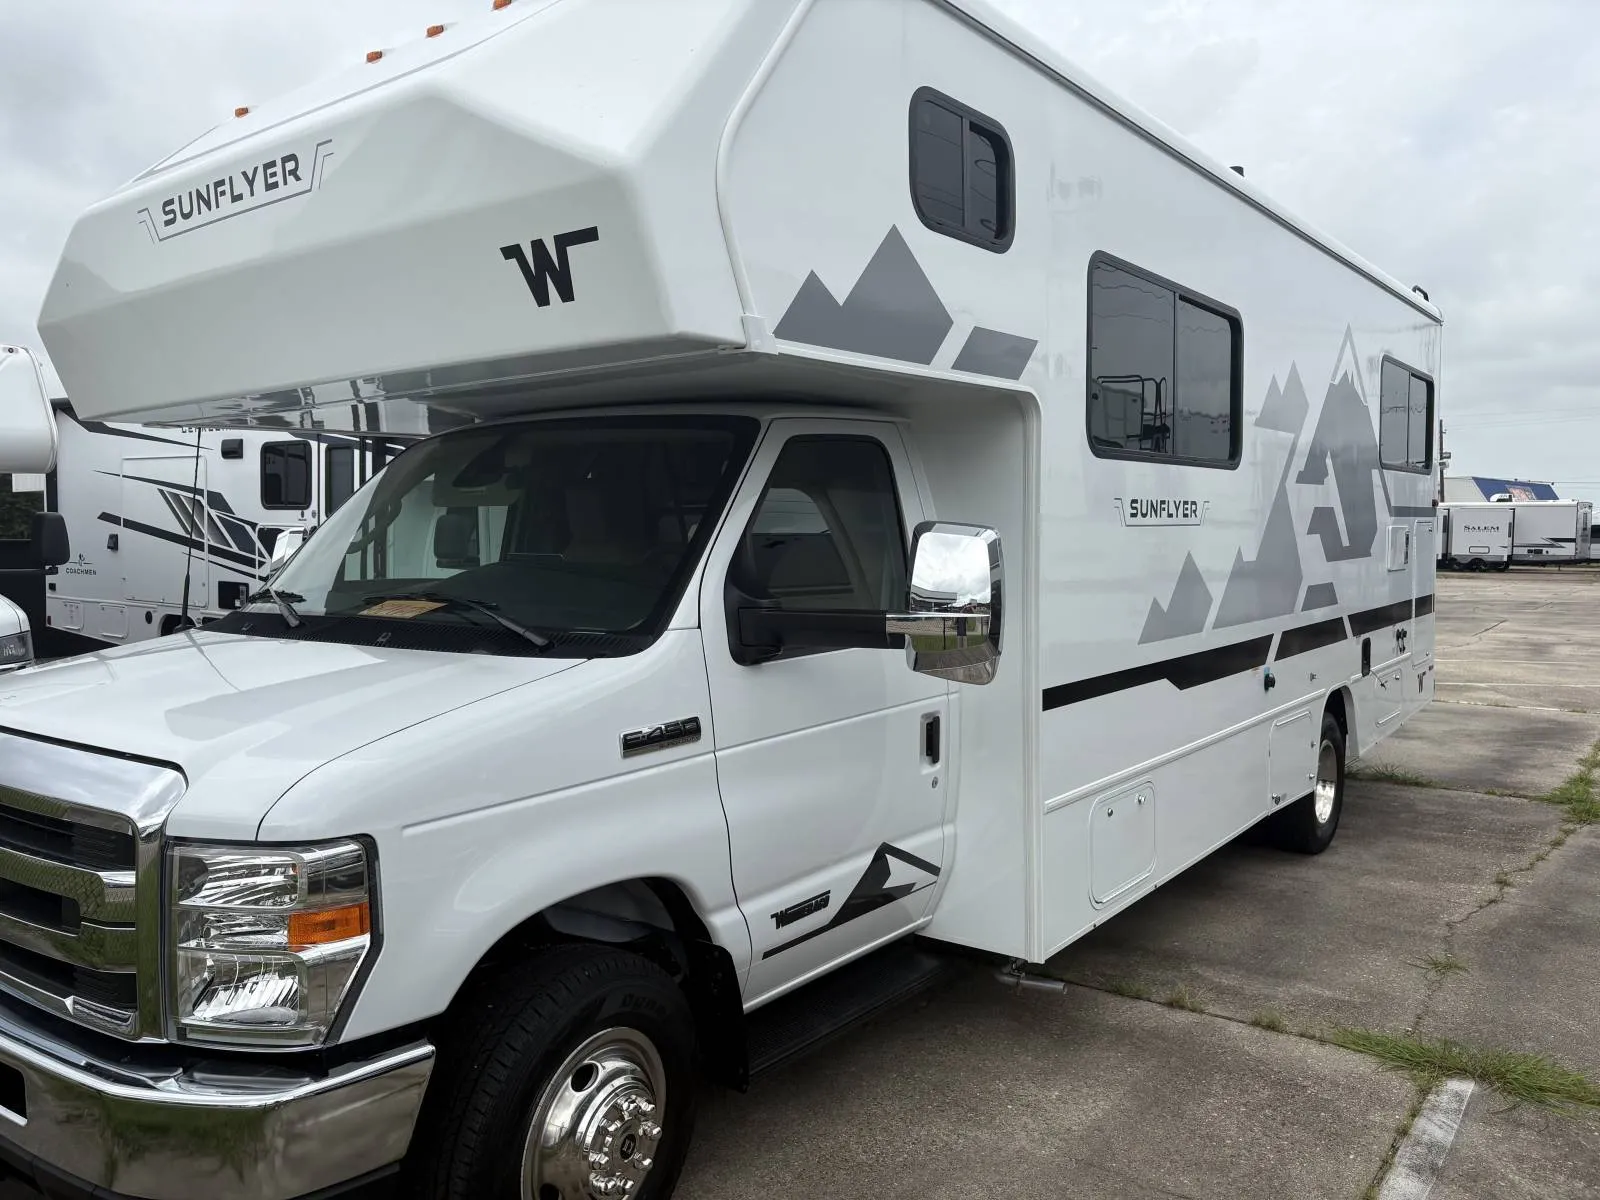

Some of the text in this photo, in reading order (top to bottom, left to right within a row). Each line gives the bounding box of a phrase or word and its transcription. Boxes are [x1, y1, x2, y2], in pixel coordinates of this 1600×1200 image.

[161, 152, 302, 227] SUNFLYER
[499, 225, 600, 308] W
[1129, 498, 1198, 519] SUNFLYER
[65, 567, 97, 576] COACHMEN
